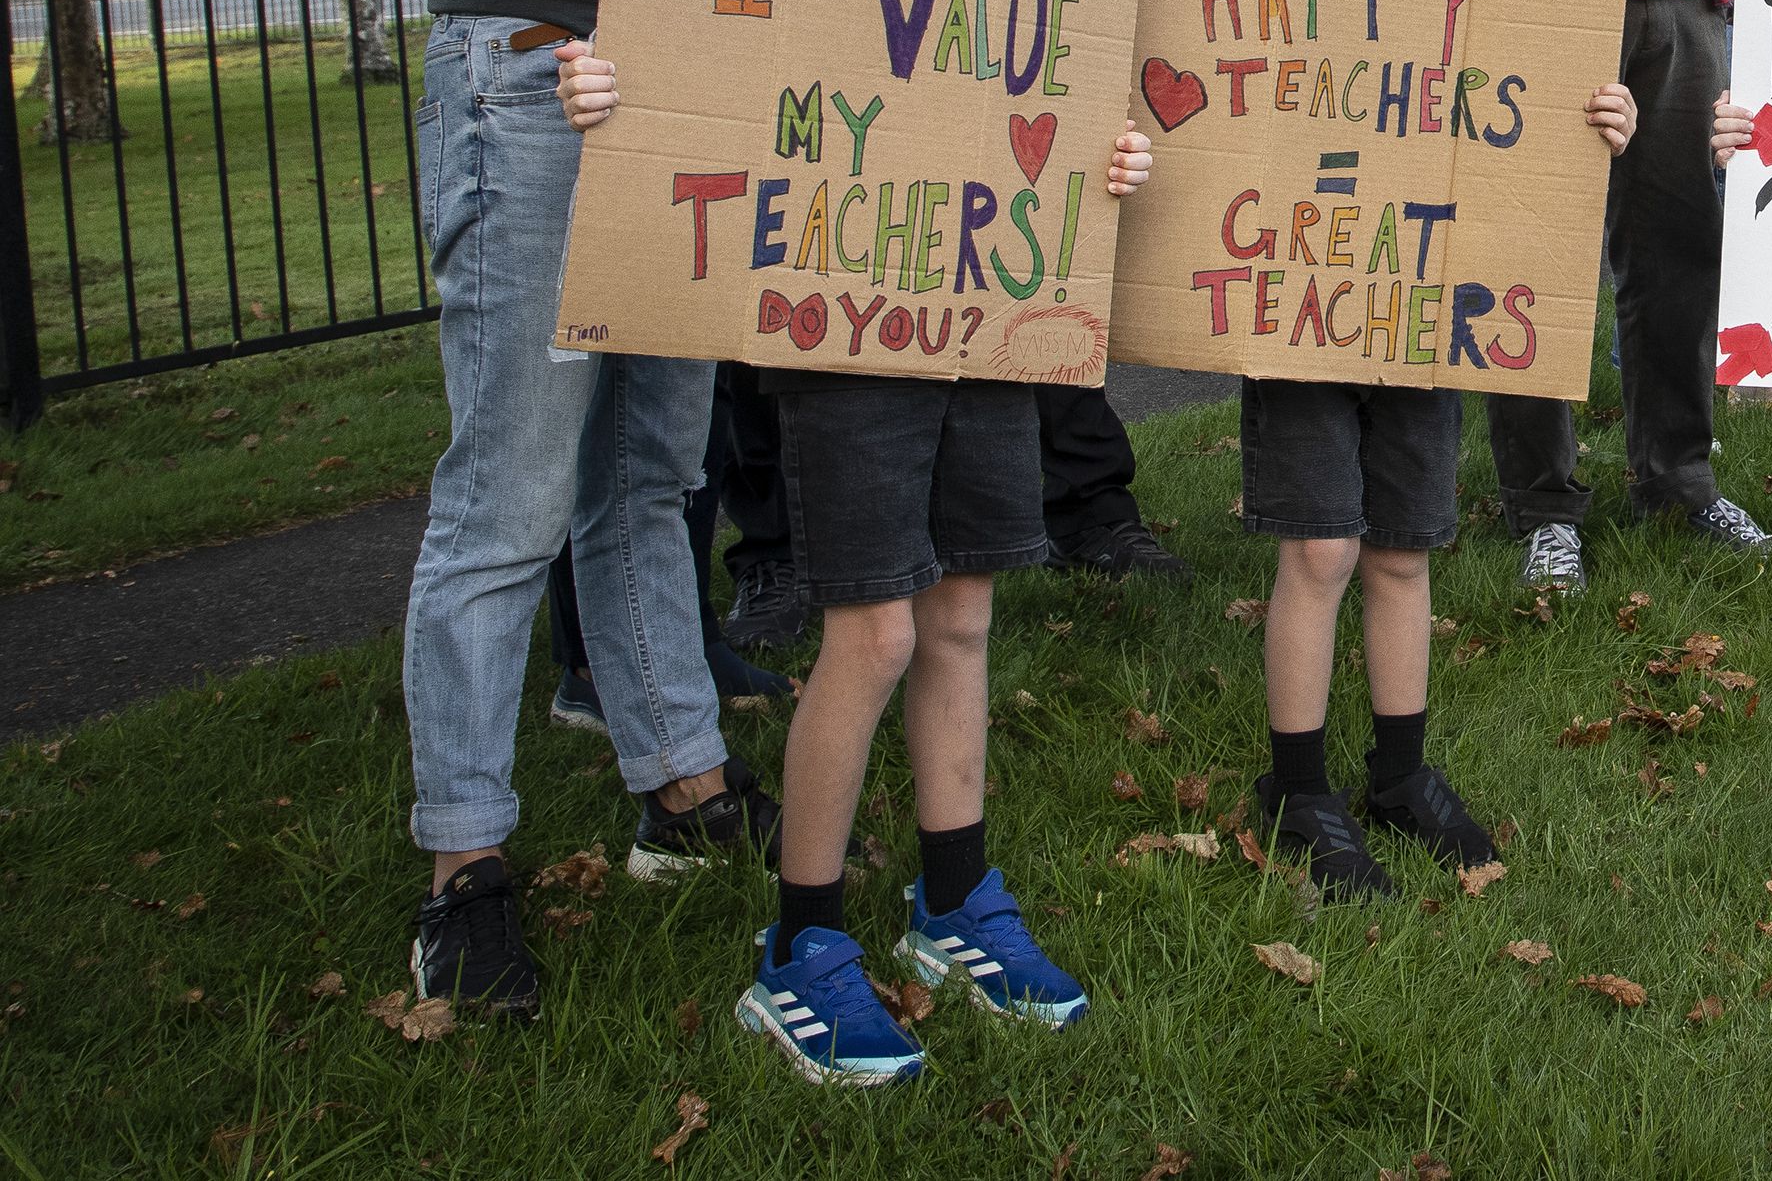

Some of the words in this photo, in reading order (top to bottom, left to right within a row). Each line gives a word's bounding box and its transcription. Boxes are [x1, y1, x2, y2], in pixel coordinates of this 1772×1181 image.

[775, 80, 885, 176] MY
[1214, 56, 1528, 150] TEACHERS
[672, 170, 1085, 304] TEACHERS!
[1220, 188, 1458, 282] GREAT
[757, 288, 828, 352] DO
[836, 291, 984, 359] YOU?
[1191, 265, 1537, 371] TEACHERS
